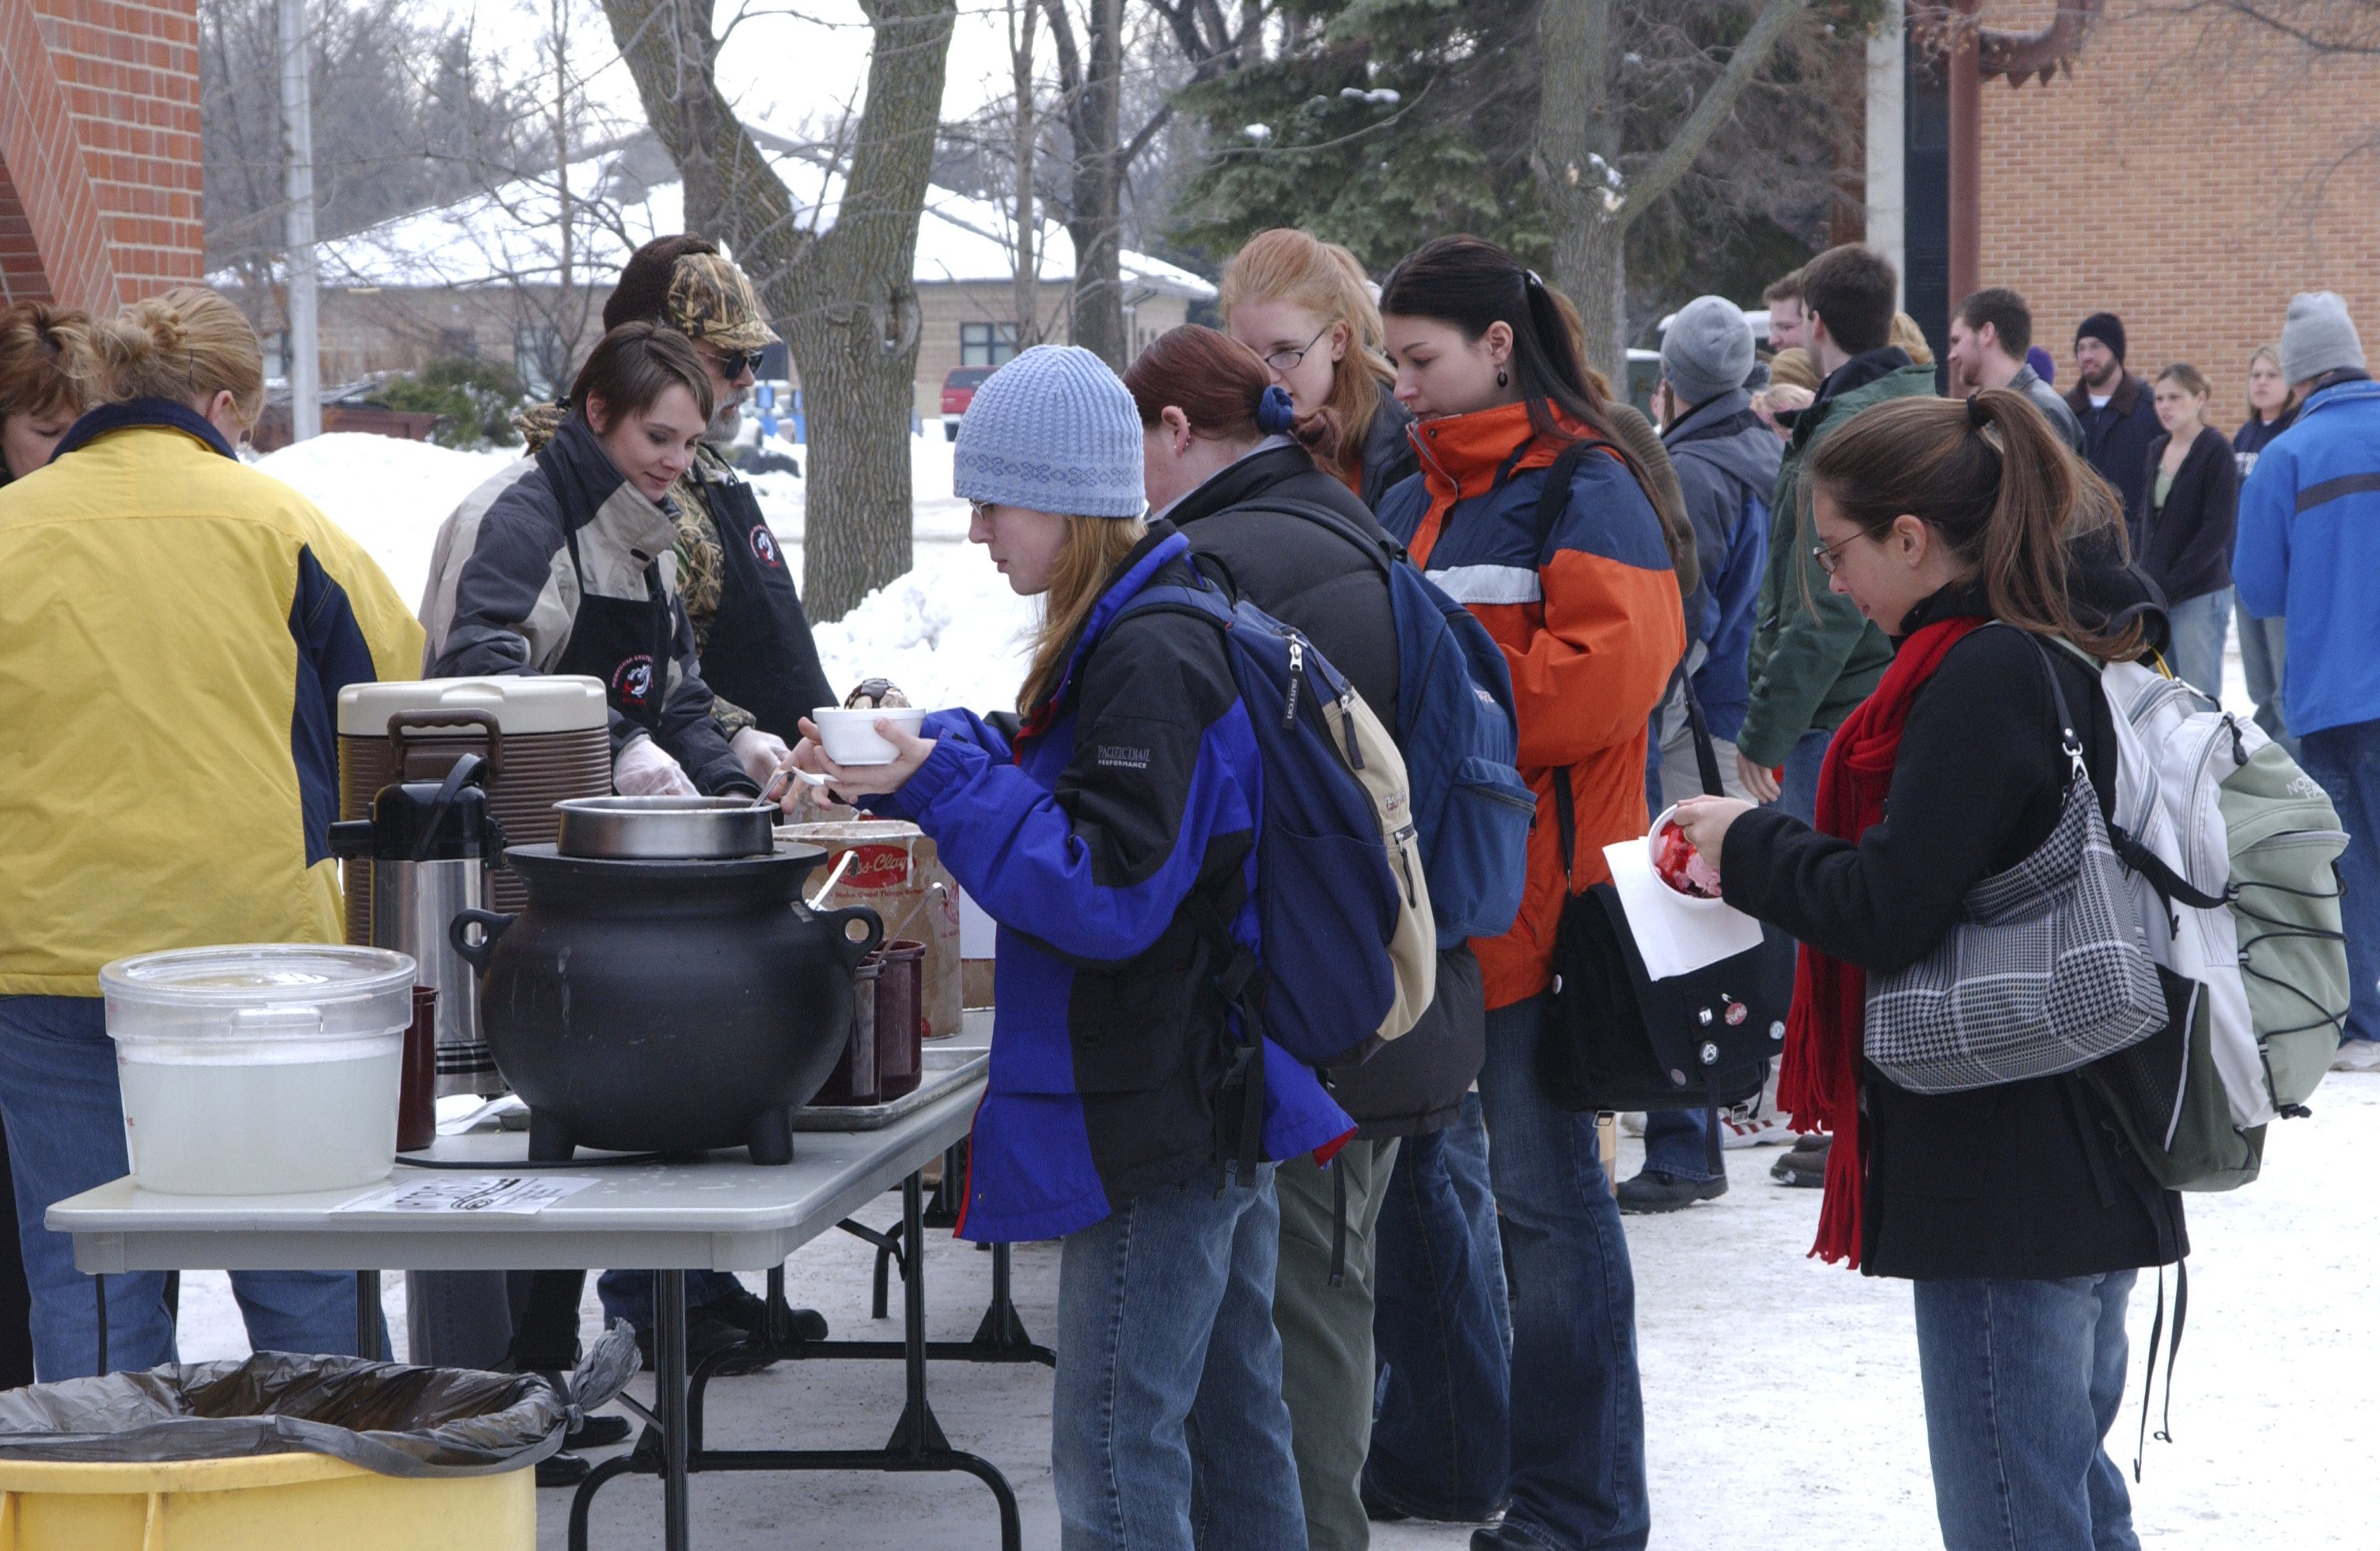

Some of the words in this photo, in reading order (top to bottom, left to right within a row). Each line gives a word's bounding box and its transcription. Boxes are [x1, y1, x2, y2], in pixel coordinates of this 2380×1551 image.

[1097, 745, 1127, 760] PACIFIC
[1127, 745, 1150, 762] TRAIL
[1097, 759, 1147, 769] PERFORMANCE
[880, 889, 903, 898] Things
